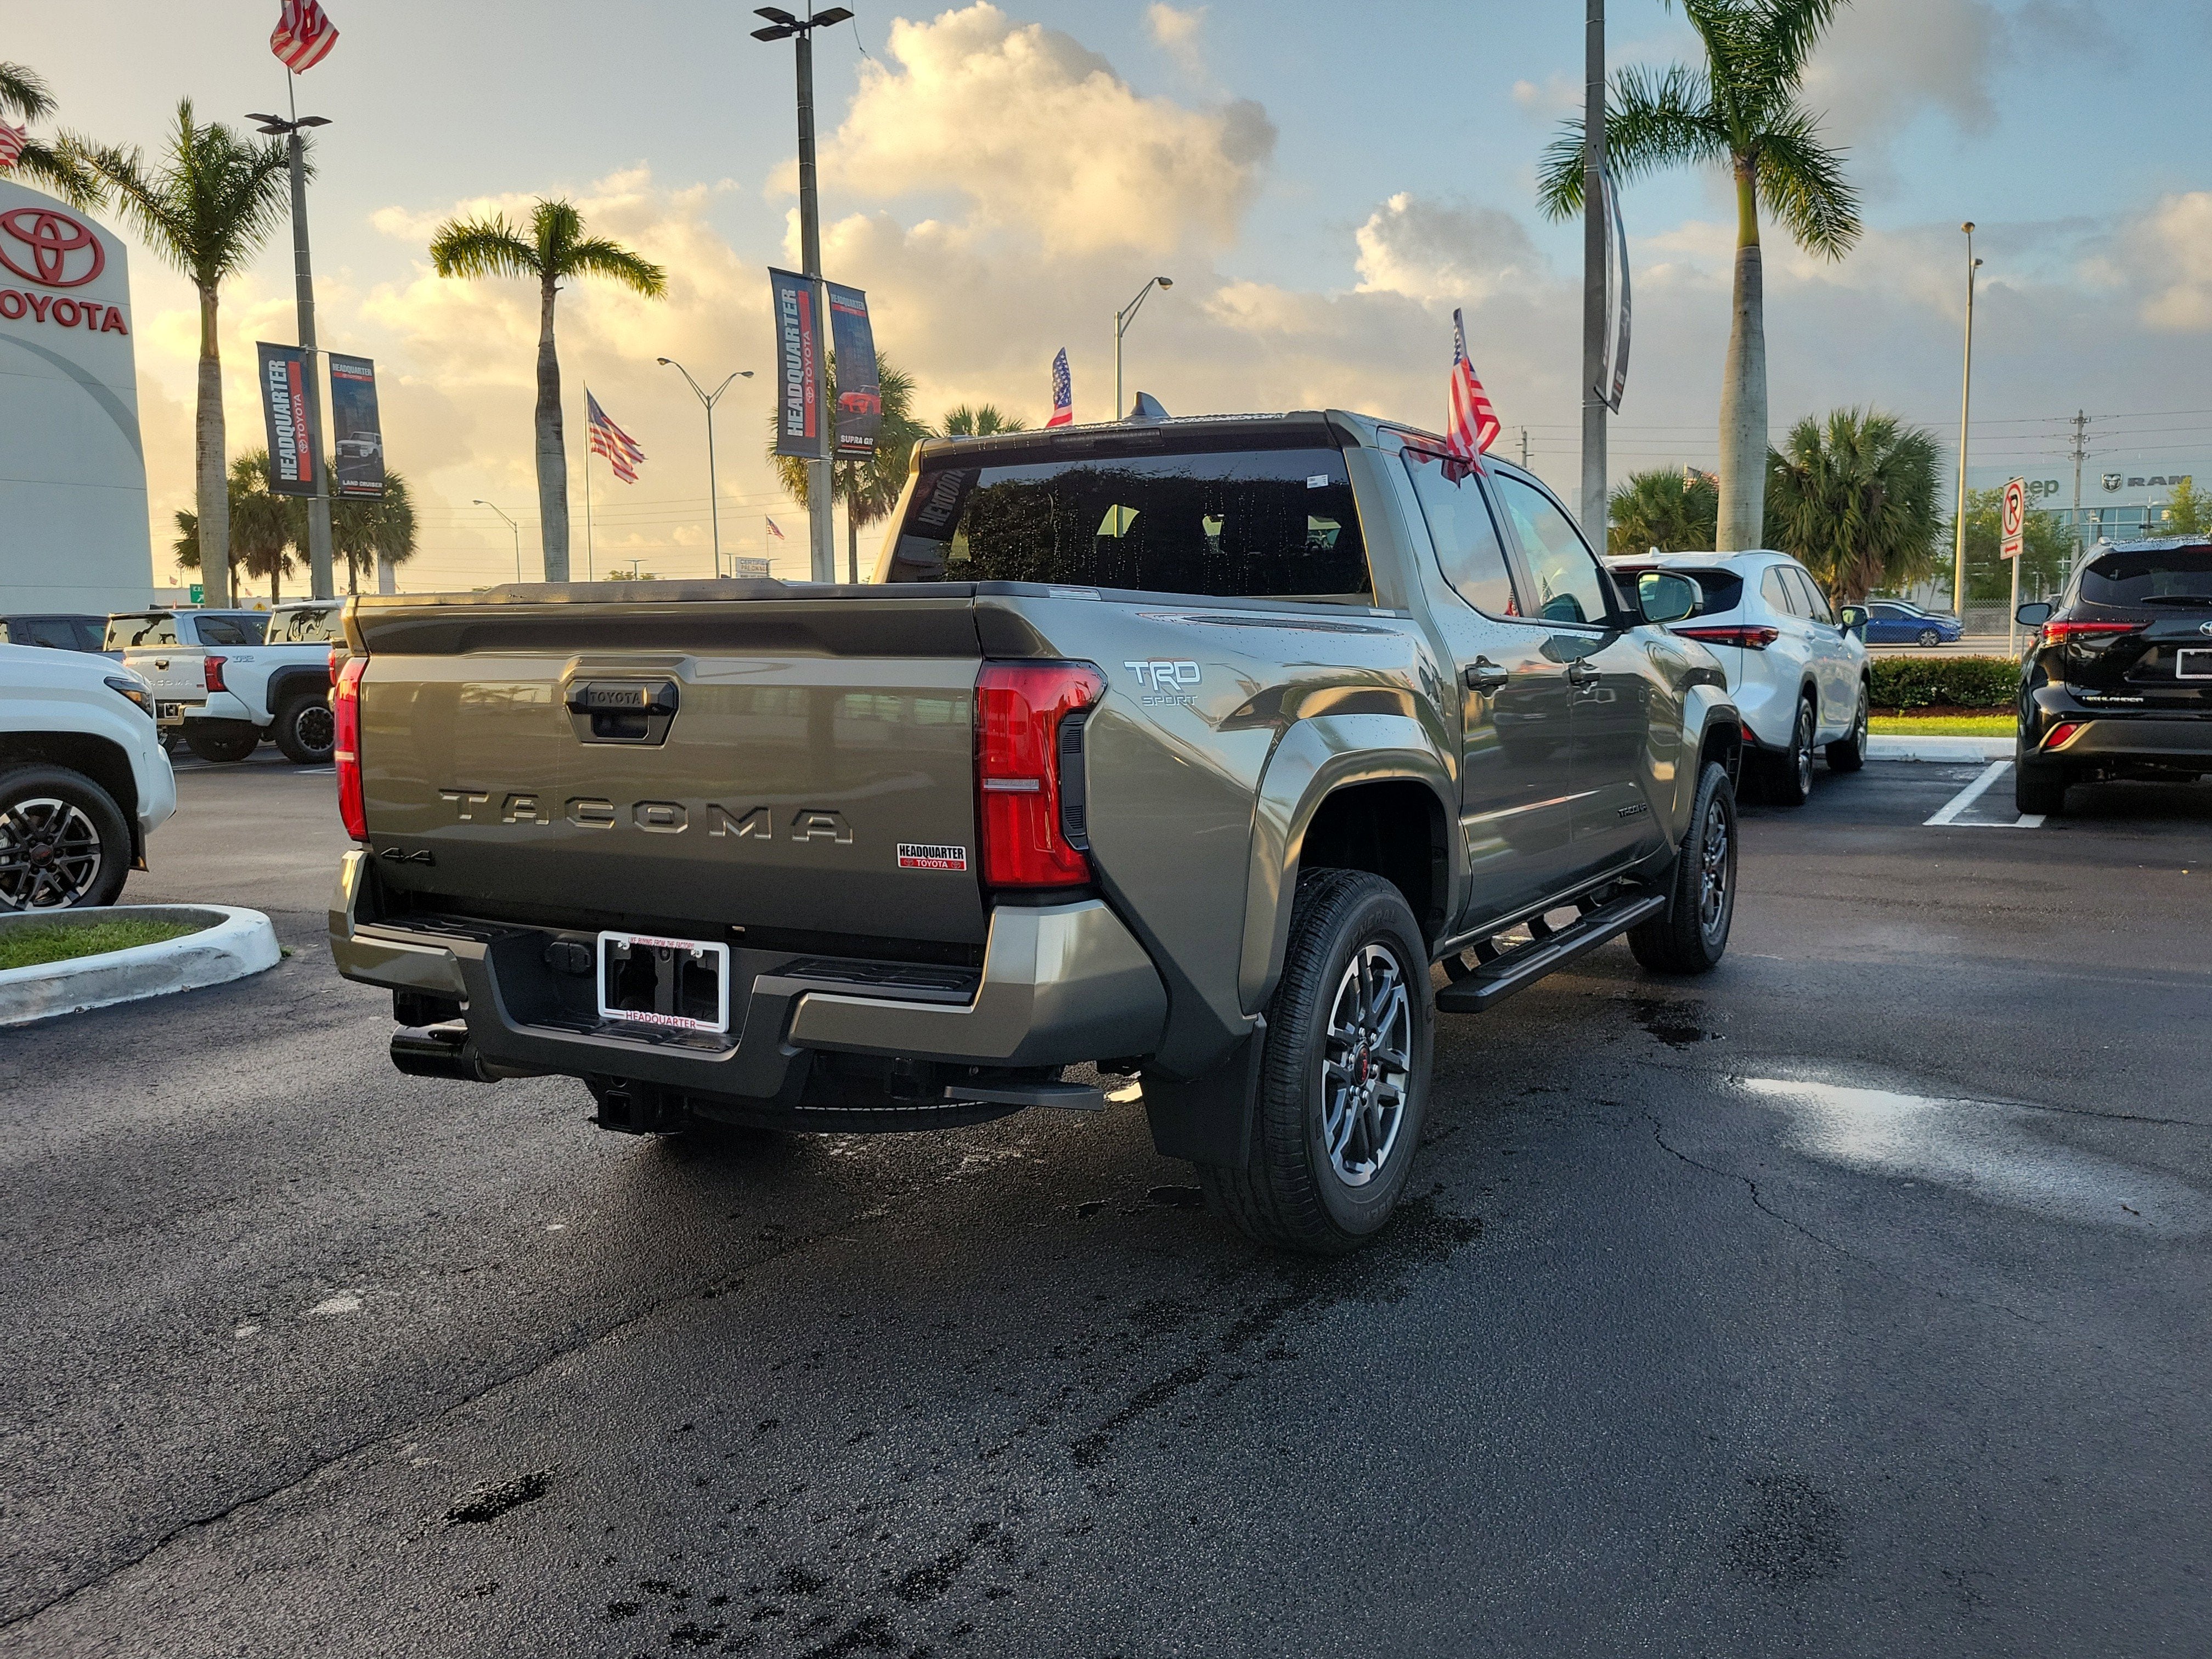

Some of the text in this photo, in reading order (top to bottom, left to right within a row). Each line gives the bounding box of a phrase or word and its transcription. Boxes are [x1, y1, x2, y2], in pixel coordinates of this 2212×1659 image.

[0, 289, 128, 335] OYOTA
[782, 289, 804, 437] HEADQUARTER
[804, 331, 814, 385] TOYOTA
[332, 363, 373, 376] HEADQUARTER
[268, 360, 297, 481] HEADQUARTER
[294, 394, 308, 438] TOYOTA
[840, 435, 873, 445] SUPRA GR
[2128, 475, 2192, 487] RAM
[1124, 661, 1201, 692] TRD
[590, 692, 640, 705] TOYOTA
[1141, 695, 1198, 707] SPORT
[439, 789, 854, 844] TACOMA
[899, 844, 964, 860] HEADQUARTER
[916, 859, 948, 868] TOYOTA
[626, 1010, 696, 1029] HEADQUARTER
